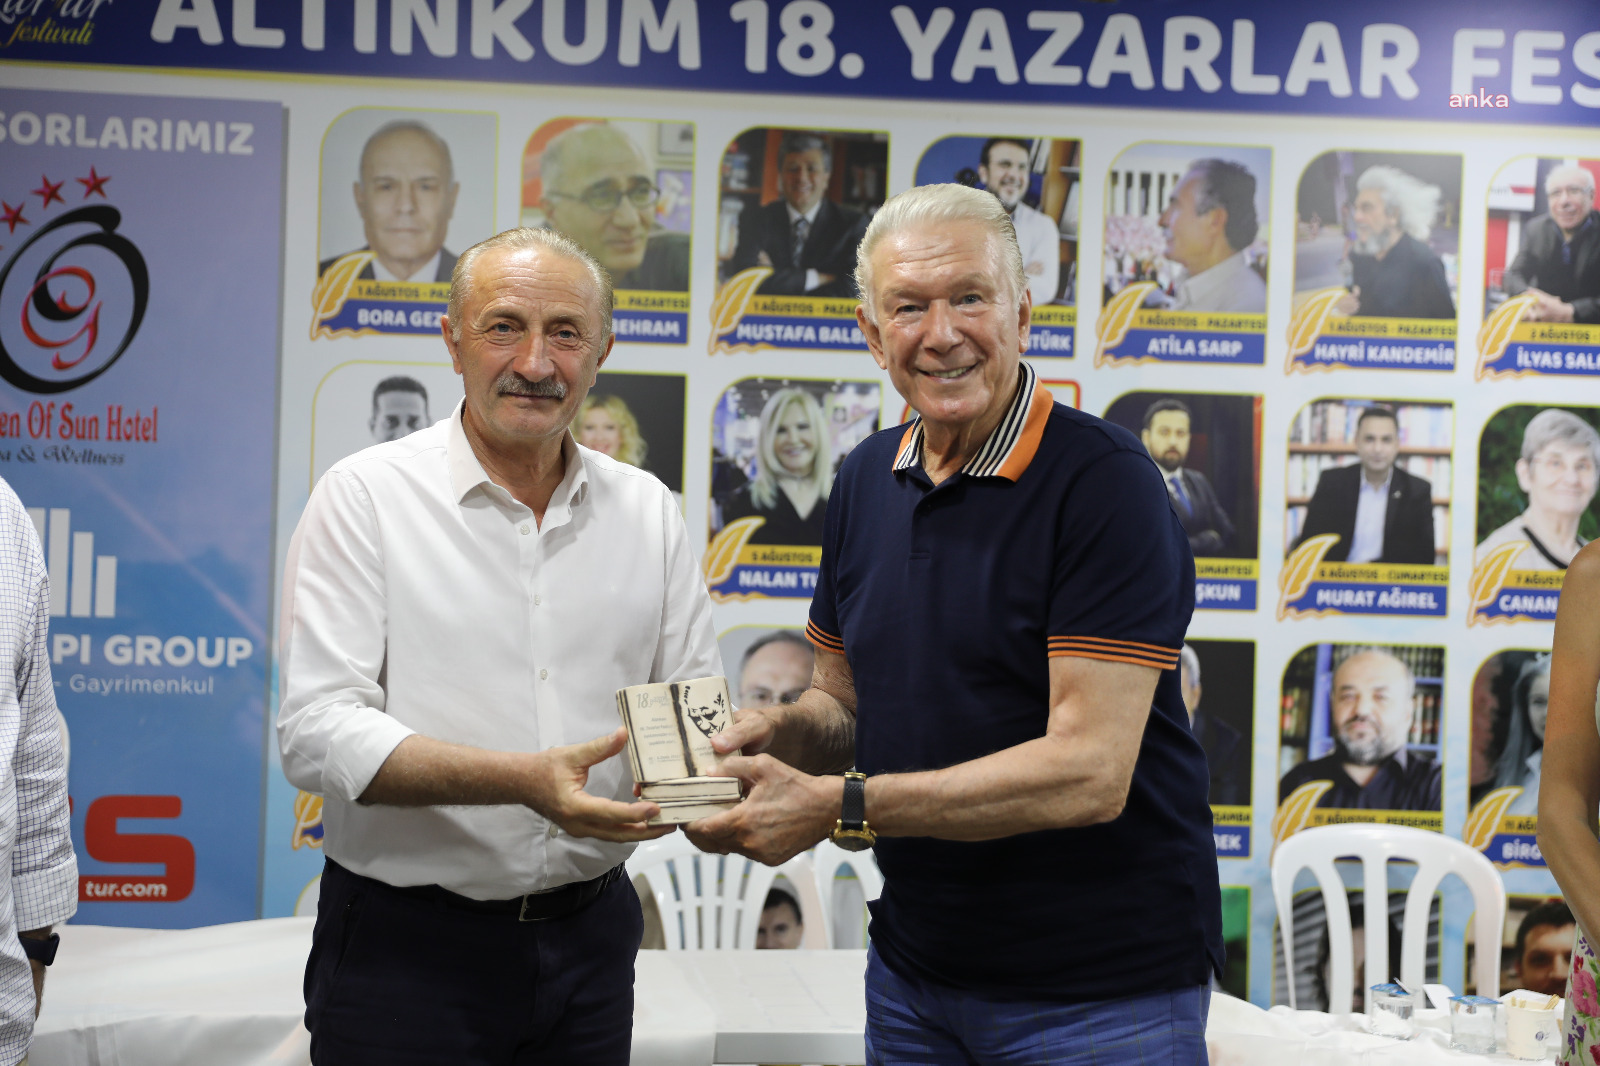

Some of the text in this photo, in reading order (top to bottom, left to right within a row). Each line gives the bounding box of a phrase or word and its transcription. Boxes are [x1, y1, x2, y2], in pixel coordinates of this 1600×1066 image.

[729, 0, 865, 79] 18.
[890, 6, 1420, 101] YAZARLAR
[365, 284, 420, 298] AĞUSTOS
[761, 300, 813, 314] AĞUSTOS
[357, 308, 407, 327] BORA
[1147, 314, 1198, 328] AĞUSTOS
[1338, 320, 1388, 334] AĞUSTOS
[736, 323, 816, 342] MUSTAFA
[1540, 326, 1590, 341] AĞUSTOS
[1147, 334, 1243, 358] ATİLA SARP
[1314, 341, 1455, 365] HAYRİ KANDEMİR
[1516, 346, 1563, 370] İLYAS
[27, 399, 55, 440] Of
[58, 402, 99, 441] Sun
[106, 404, 158, 443] Hotel
[43, 445, 125, 466] Wellness
[761, 548, 813, 562] AĞUSTOS
[738, 571, 798, 588] NALAN
[1329, 566, 1378, 579] AĞUSTOS
[1316, 586, 1438, 609] MURAT AĞIREL
[103, 634, 253, 668] GROUP
[69, 673, 214, 697] Gayrimenkul
[85, 881, 168, 897] tur.com
